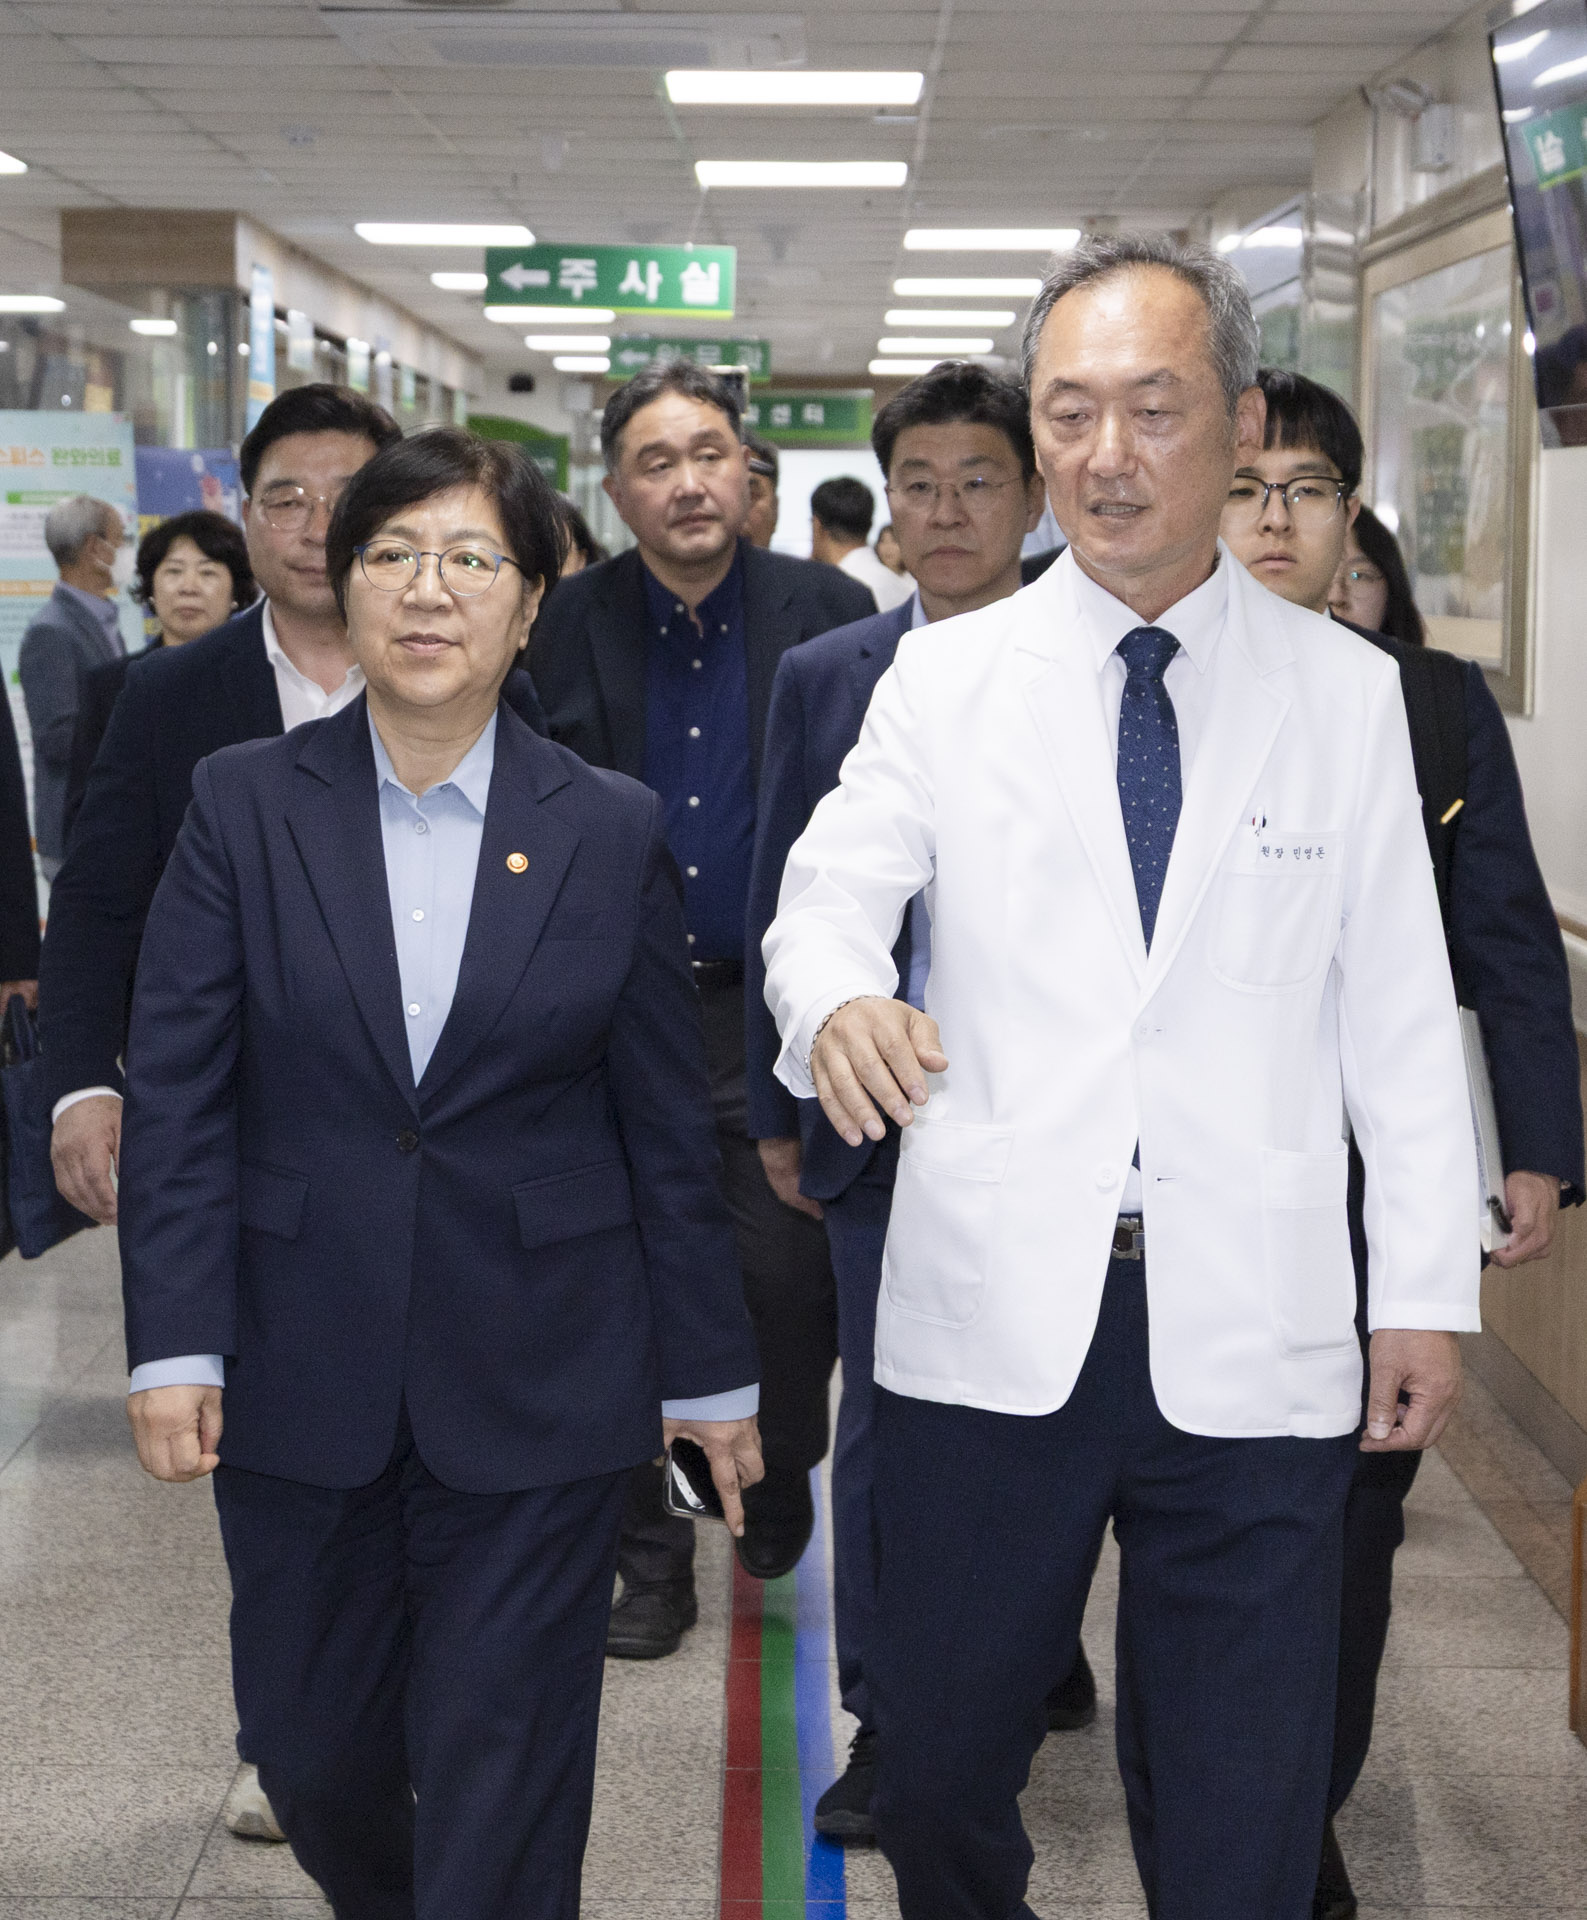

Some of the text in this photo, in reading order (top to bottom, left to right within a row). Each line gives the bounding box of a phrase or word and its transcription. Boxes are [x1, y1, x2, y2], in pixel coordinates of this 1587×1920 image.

[559, 258, 720, 304] 주사실
[51, 447, 122, 467] 완화의료
[1261, 846, 1325, 860] 원장 민영돈
